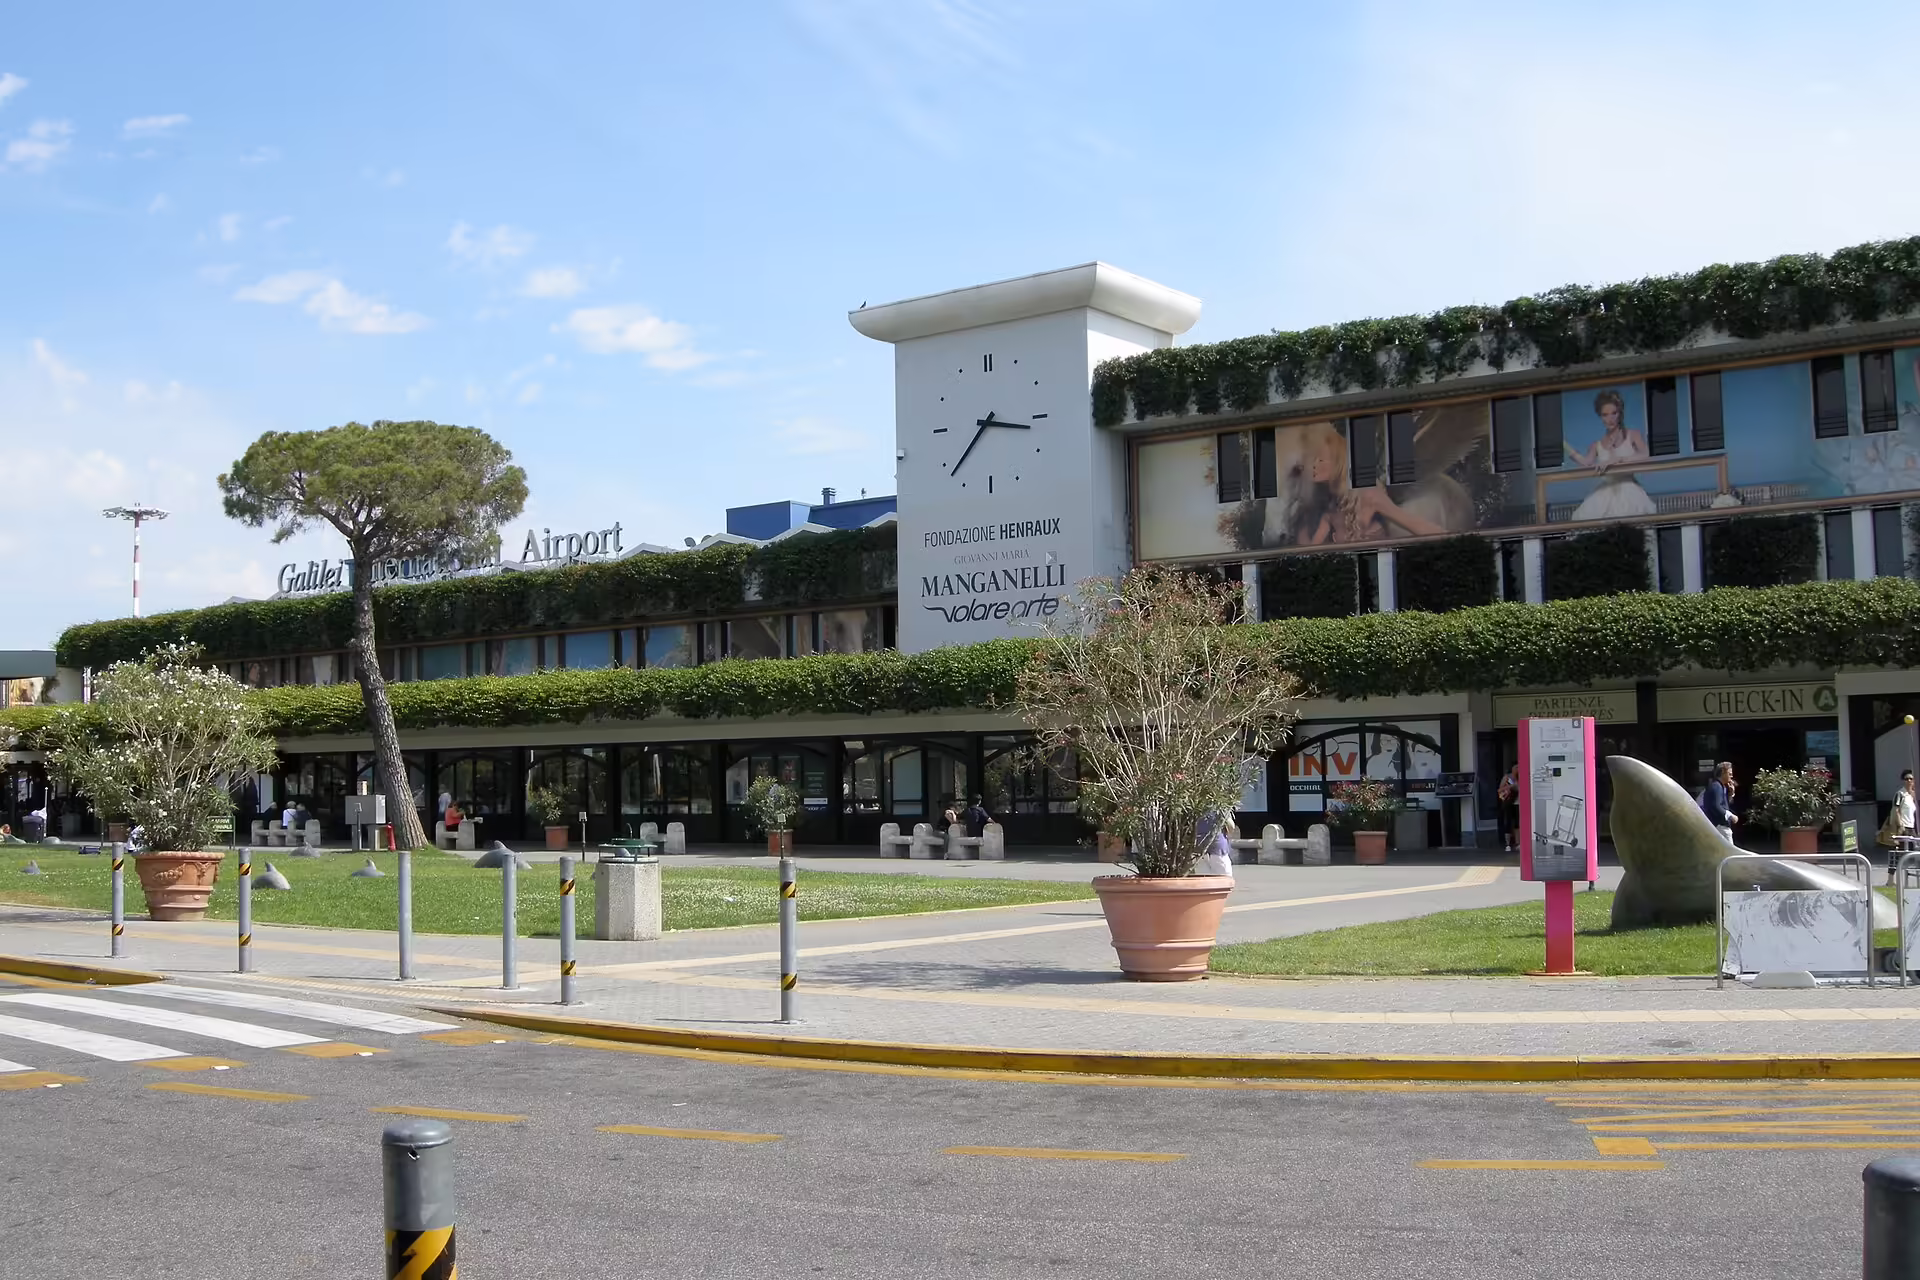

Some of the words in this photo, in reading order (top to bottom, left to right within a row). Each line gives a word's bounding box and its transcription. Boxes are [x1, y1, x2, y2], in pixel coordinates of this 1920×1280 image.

[924, 525, 996, 548] FONDAZIONE
[999, 517, 1061, 541] HENRAUX
[278, 558, 344, 593] Galilei
[519, 521, 623, 565] Airport
[954, 551, 998, 565] GIOVANNI
[1001, 549, 1030, 561] MARIA
[921, 564, 1067, 598] MANGANELLI
[1534, 696, 1606, 710] PARTENZE
[1703, 688, 1805, 715] CHECK-IN
[1818, 687, 1837, 709] A
